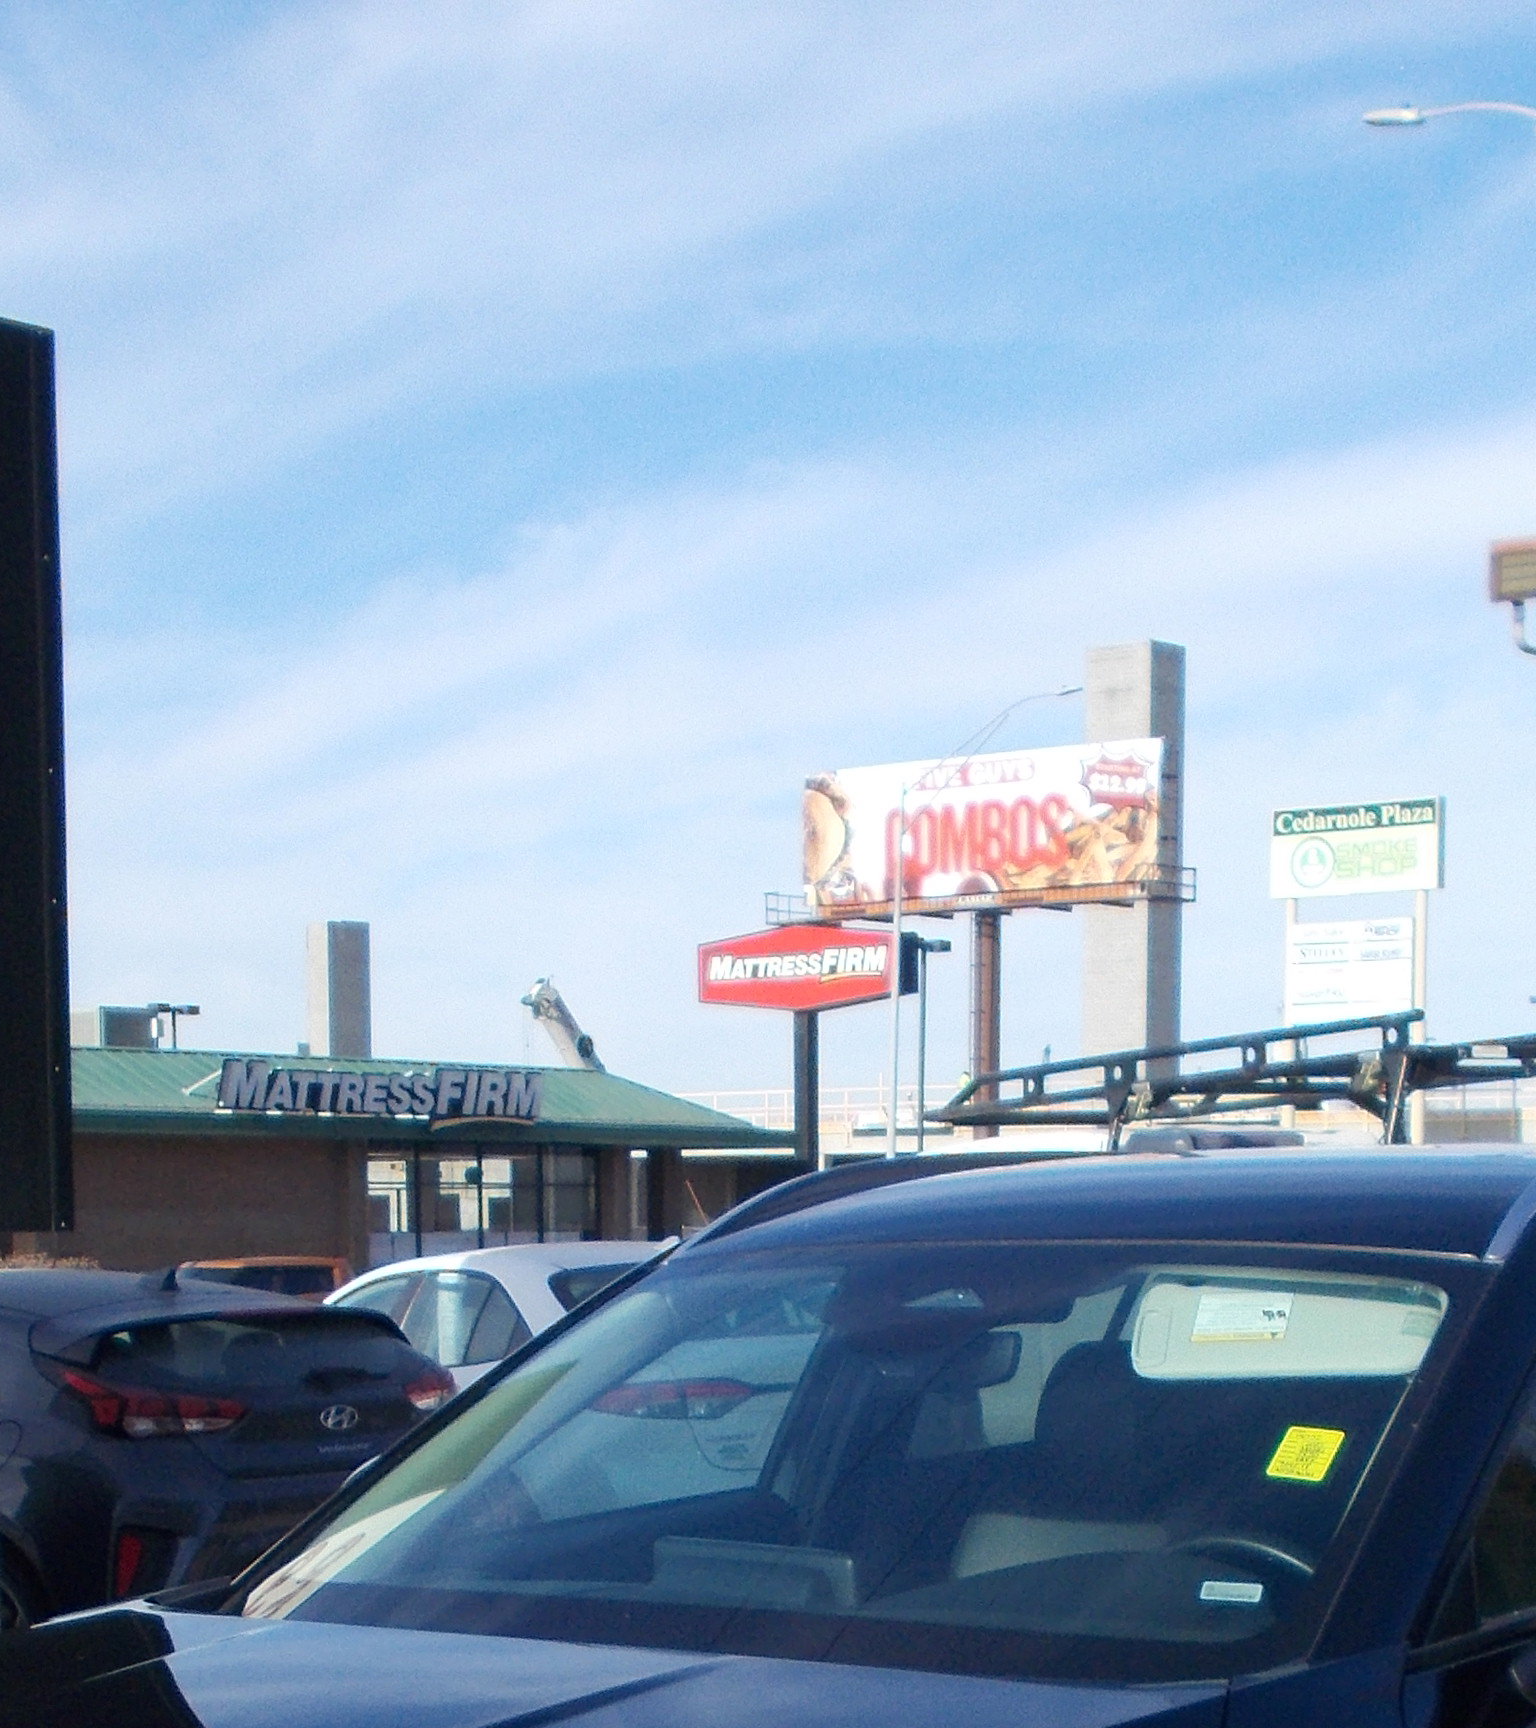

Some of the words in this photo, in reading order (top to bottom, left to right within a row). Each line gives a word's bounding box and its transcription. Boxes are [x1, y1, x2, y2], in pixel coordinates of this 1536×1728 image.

[1276, 808, 1376, 833] Cedarnole
[1381, 804, 1434, 824] Plaza
[883, 792, 1072, 899] COMBOS
[1335, 838, 1417, 857] SMOKE
[1334, 856, 1417, 879] SHOP
